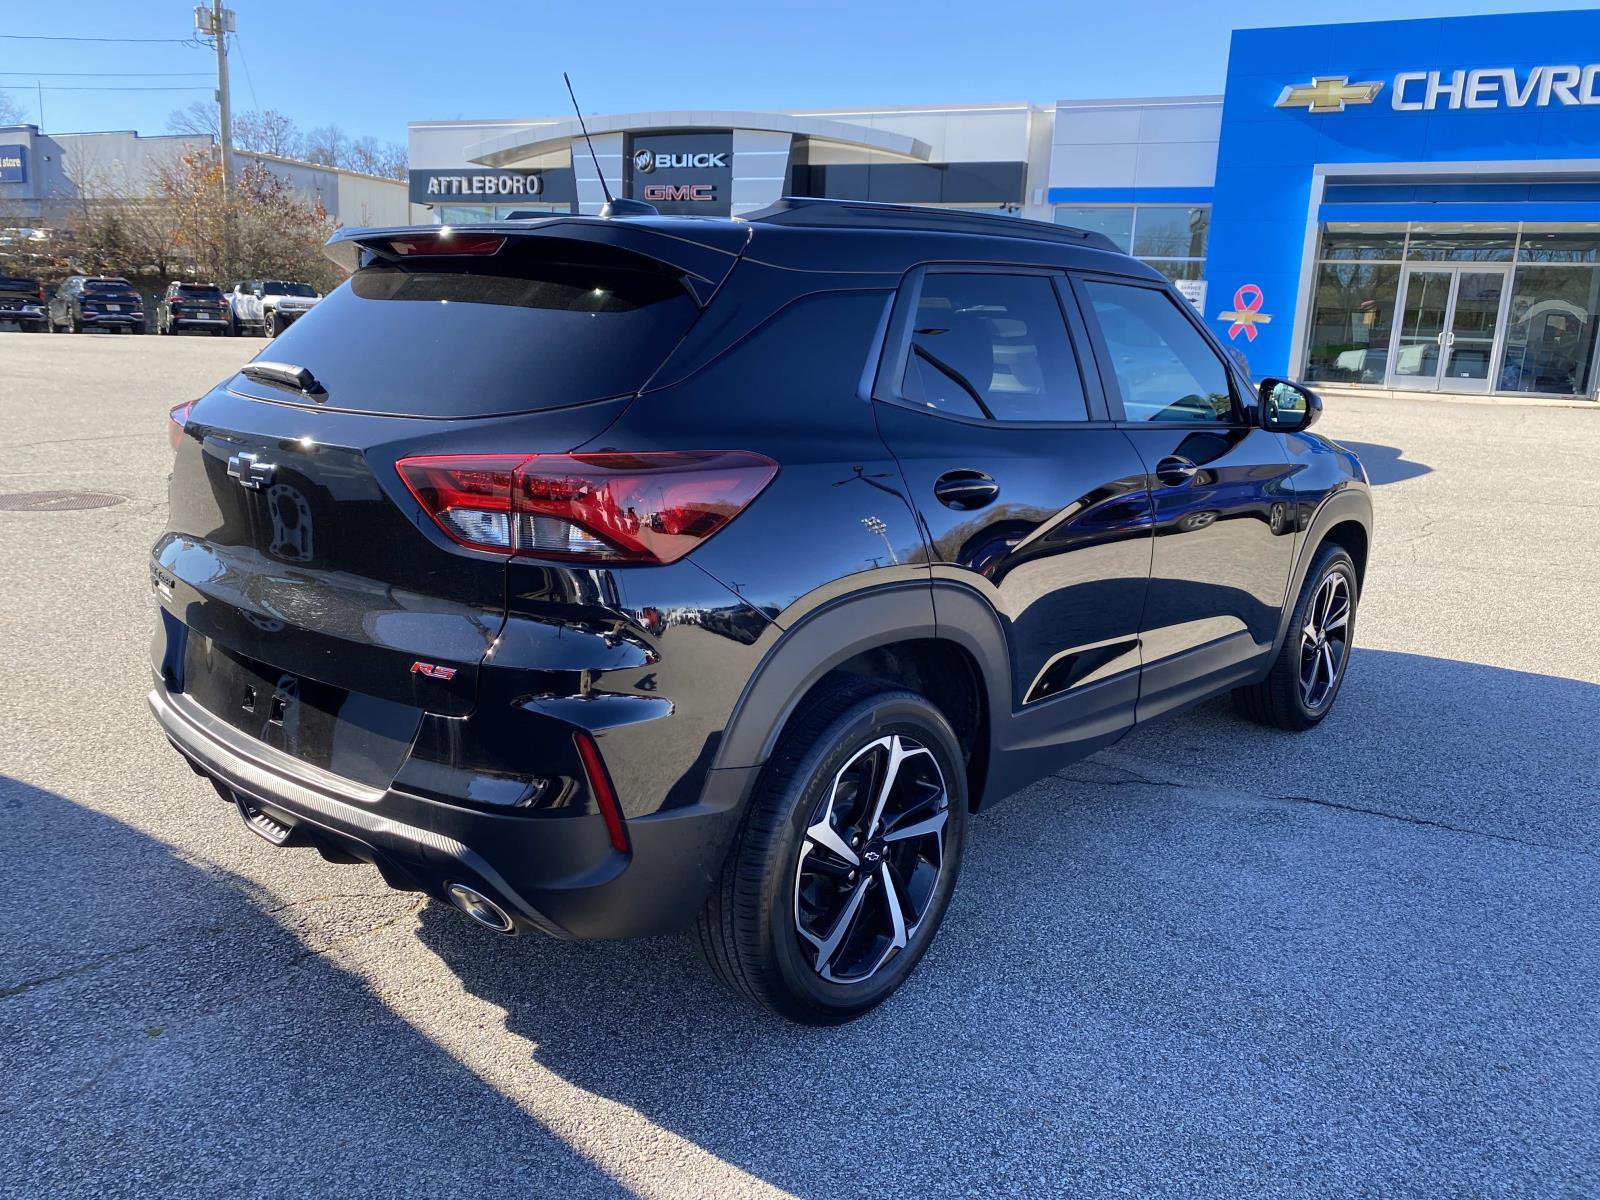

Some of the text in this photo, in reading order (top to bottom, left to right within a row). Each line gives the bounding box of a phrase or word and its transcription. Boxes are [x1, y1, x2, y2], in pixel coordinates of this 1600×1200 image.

[2, 156, 21, 168] store
[655, 152, 726, 168] BUICK
[427, 175, 539, 195] ATTLEBORO
[644, 184, 713, 201] GMC
[410, 661, 457, 680] RS
